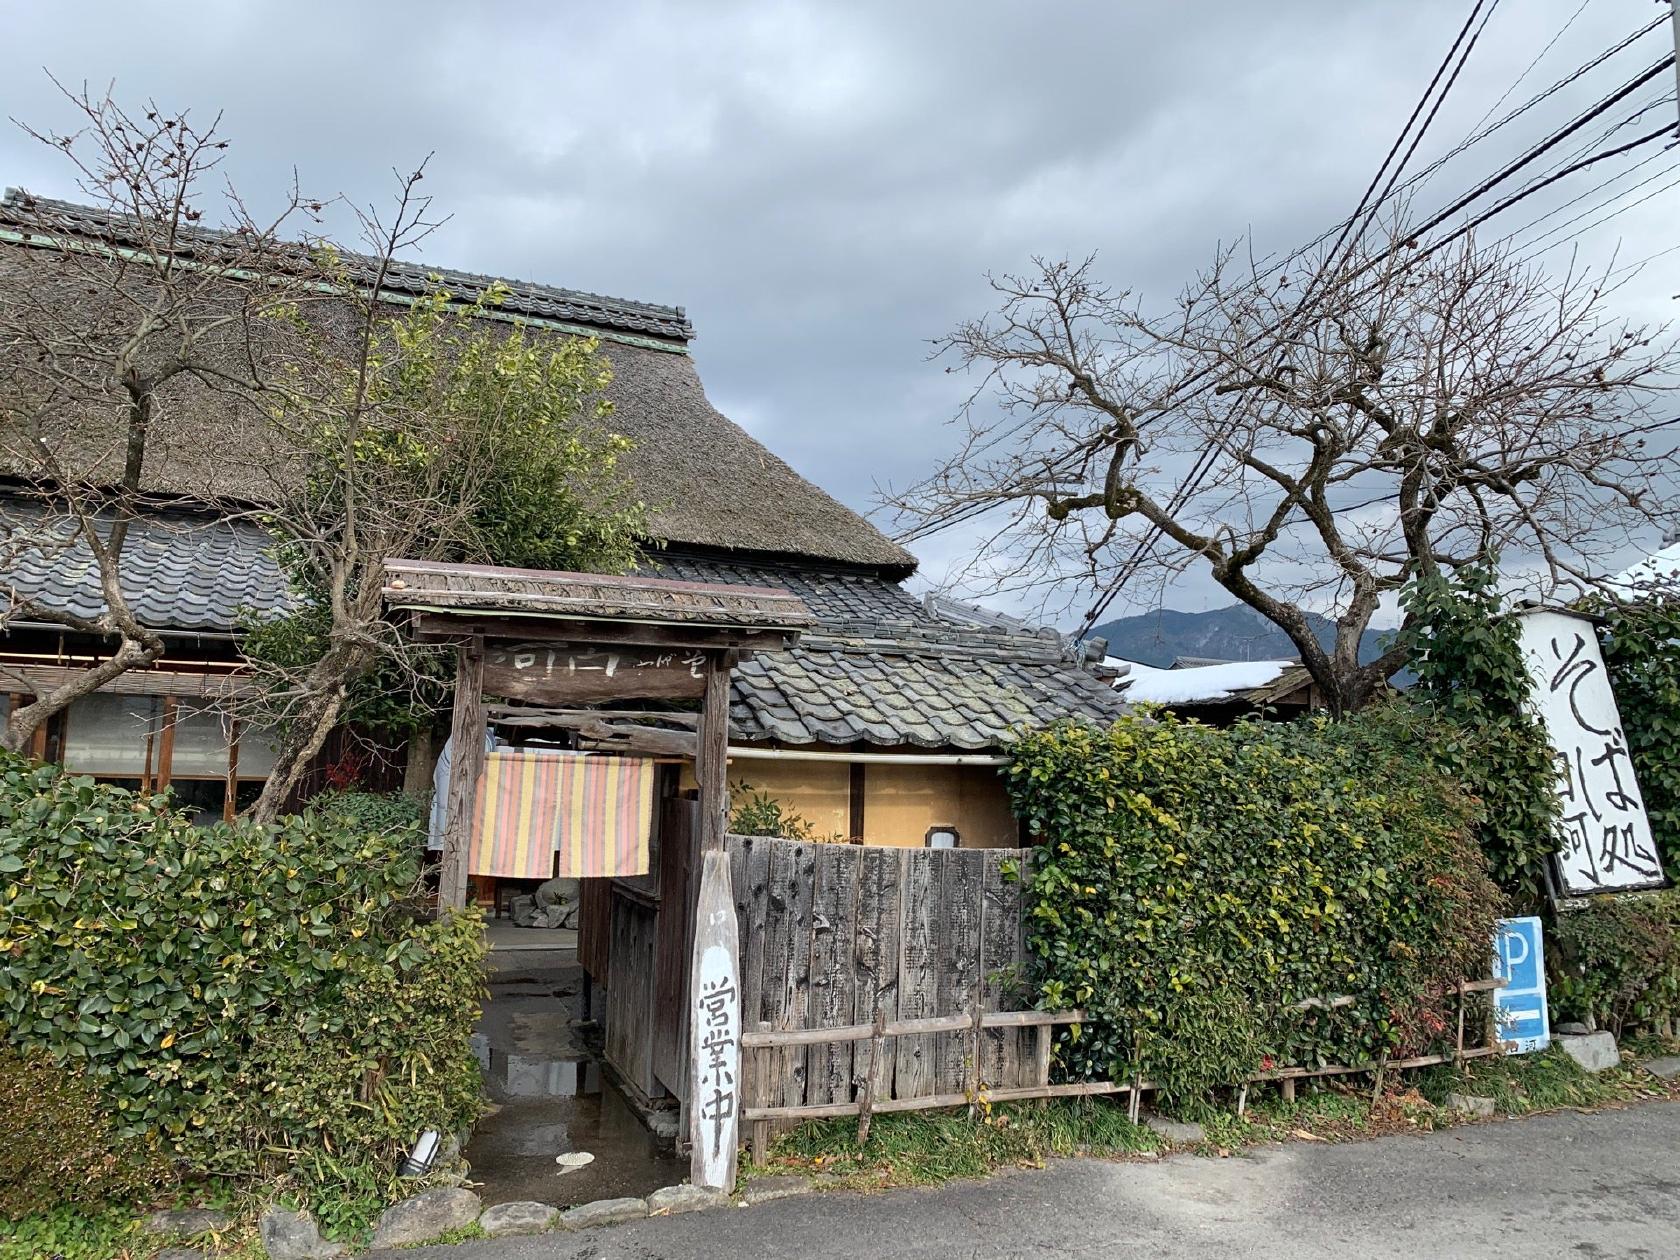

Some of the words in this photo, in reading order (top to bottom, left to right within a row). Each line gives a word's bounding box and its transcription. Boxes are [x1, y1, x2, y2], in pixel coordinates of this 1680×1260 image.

[1549, 633, 1660, 877] そば処
[1504, 931, 1529, 982] P
[700, 976, 736, 1161] 営業中
